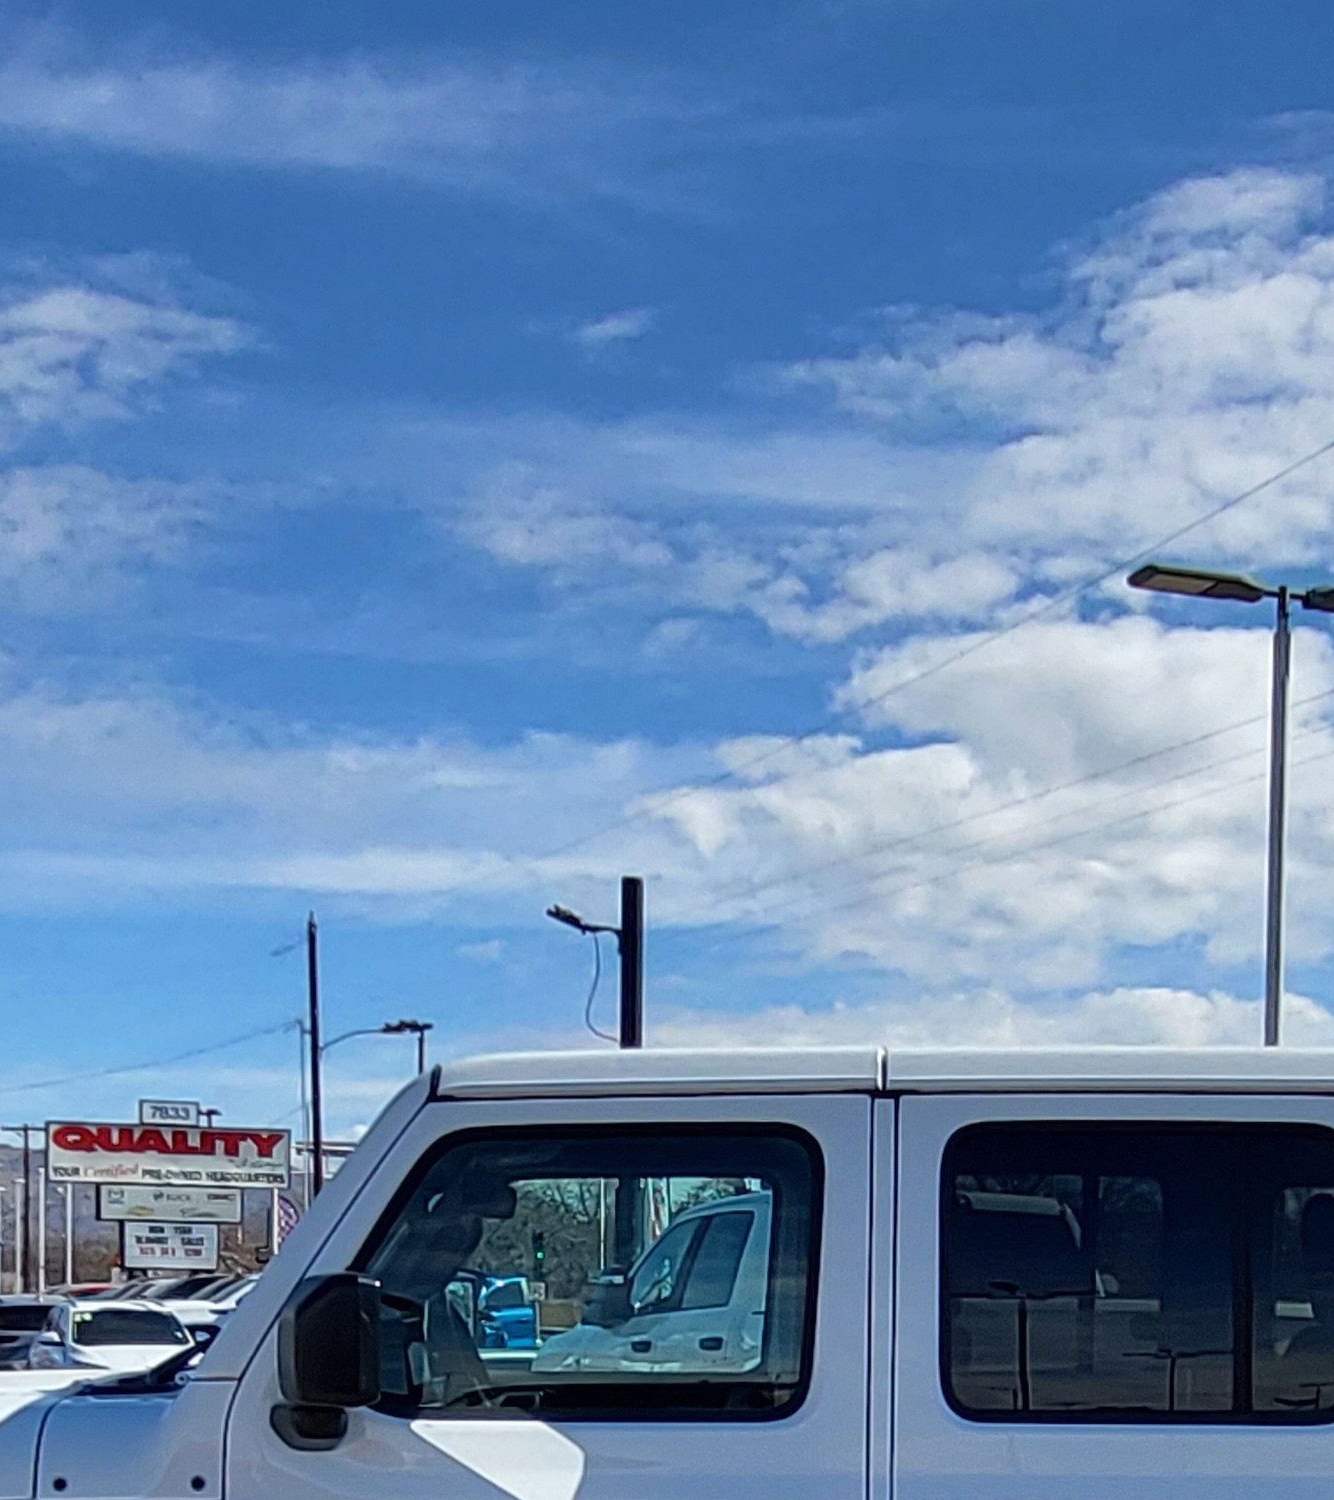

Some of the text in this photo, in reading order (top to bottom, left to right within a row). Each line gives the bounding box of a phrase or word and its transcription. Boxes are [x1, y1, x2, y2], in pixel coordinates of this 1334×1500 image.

[150, 1105, 191, 1120] 7833
[52, 1126, 285, 1158] QUALITY
[52, 1165, 81, 1177] YOUR
[84, 1163, 139, 1177] Certified
